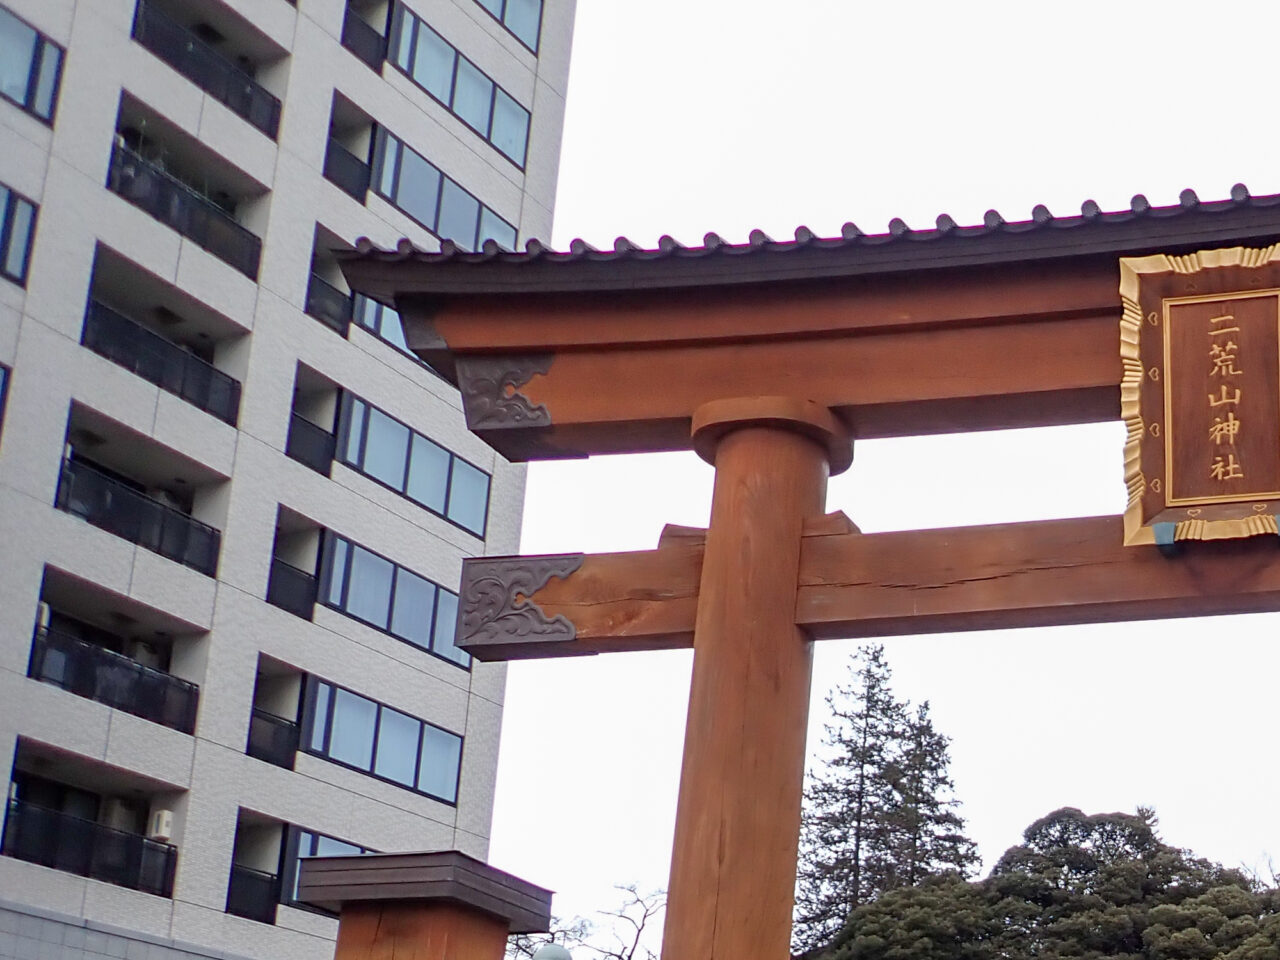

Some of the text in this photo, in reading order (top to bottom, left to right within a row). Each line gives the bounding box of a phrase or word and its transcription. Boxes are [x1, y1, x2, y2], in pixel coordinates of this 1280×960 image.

[1208, 314, 1244, 481] 二荒山神社
